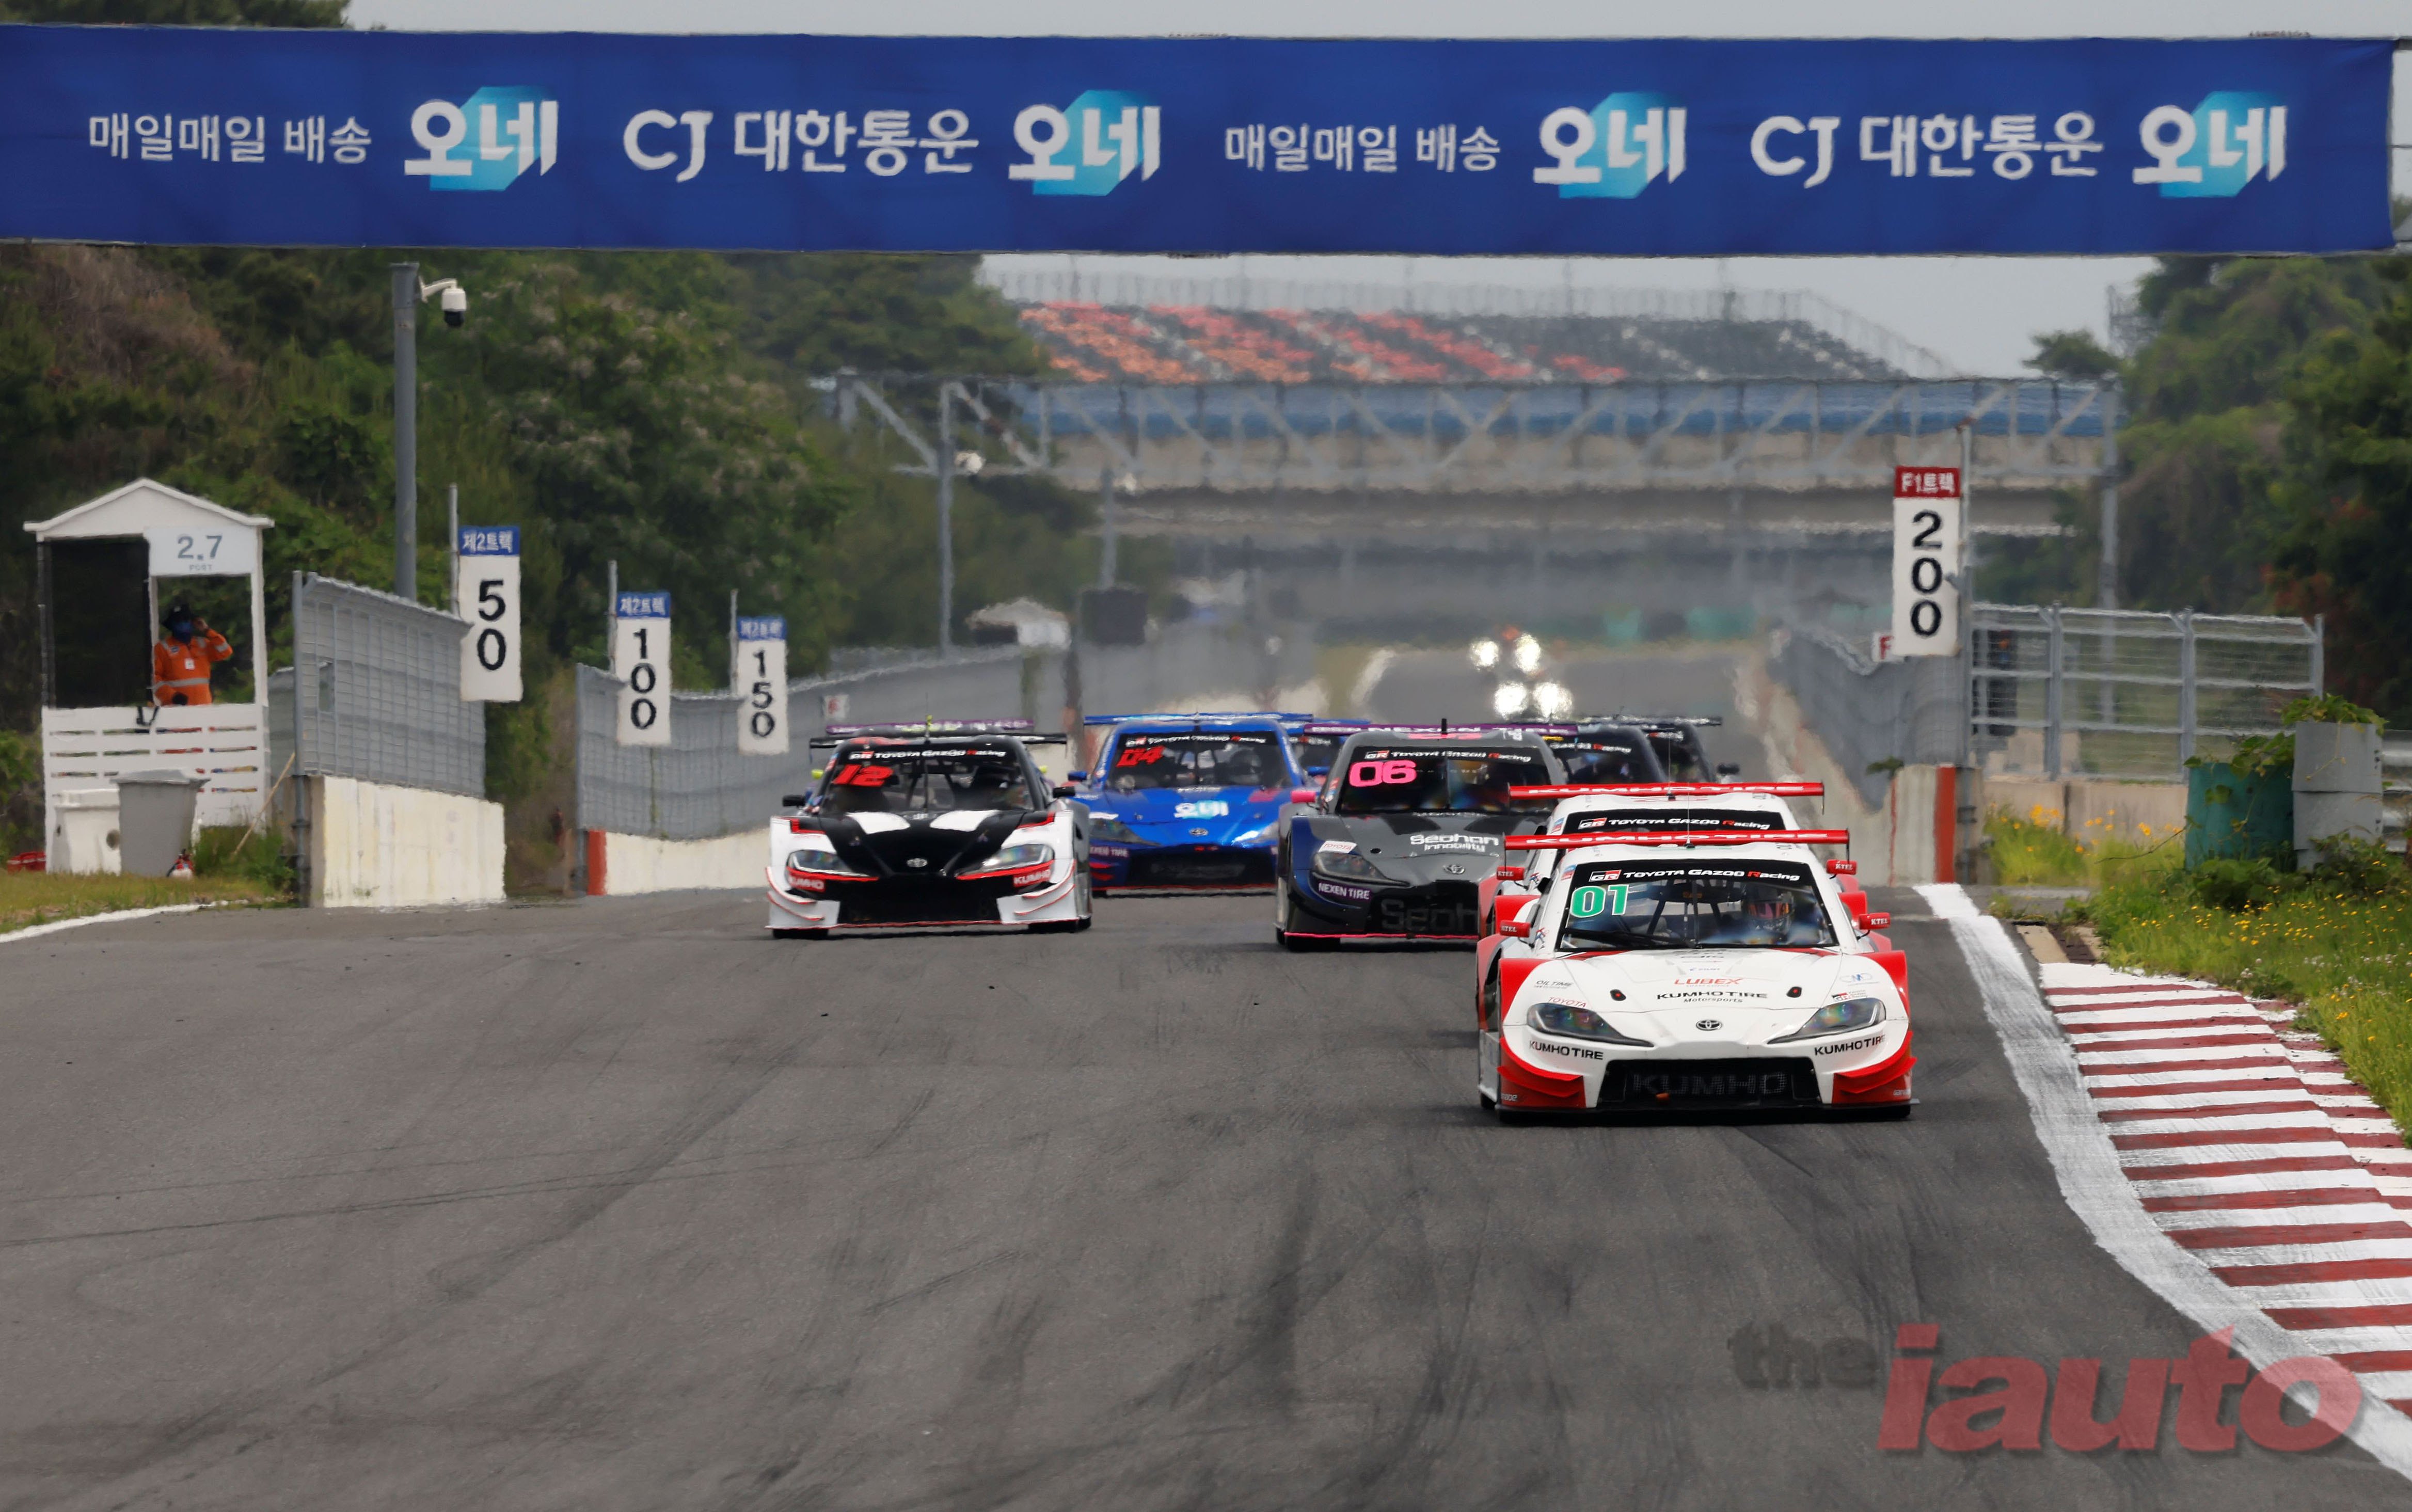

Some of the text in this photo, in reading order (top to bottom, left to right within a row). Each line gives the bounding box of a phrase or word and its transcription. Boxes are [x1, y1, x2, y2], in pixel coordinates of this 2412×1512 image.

[89, 113, 371, 163] 매일매일 배송
[404, 98, 559, 176] 오네
[623, 109, 979, 182] CJ 대한통운
[1008, 104, 1161, 181] 오네
[1225, 124, 1501, 173] 매일매일 배송
[1533, 106, 1687, 185] 오네
[1750, 112, 2103, 188] CJ 대한통운
[2133, 104, 2288, 184] 오네
[1901, 472, 1955, 494] F1트랙
[177, 534, 223, 561] 2.7
[463, 531, 513, 553] 제2트랙
[1911, 508, 1943, 638] 200
[477, 579, 506, 671] 50
[630, 628, 657, 730] 100
[751, 648, 775, 738] 150
[1348, 759, 1418, 788] 06
[1488, 752, 1532, 762] Racing
[832, 764, 894, 787] 12
[1410, 833, 1499, 846] Seohan
[1579, 819, 1606, 829] GR
[1722, 819, 1771, 831] Racing
[1319, 882, 1371, 900] NEXEN TIRE
[1590, 869, 1801, 882] GR TOYOTA GAZOO Racing
[1381, 898, 1479, 931] Seoh
[1570, 884, 1629, 918] 01
[1548, 996, 1587, 1008] TOYOTA
[1633, 1072, 1788, 1095] KUMHO
